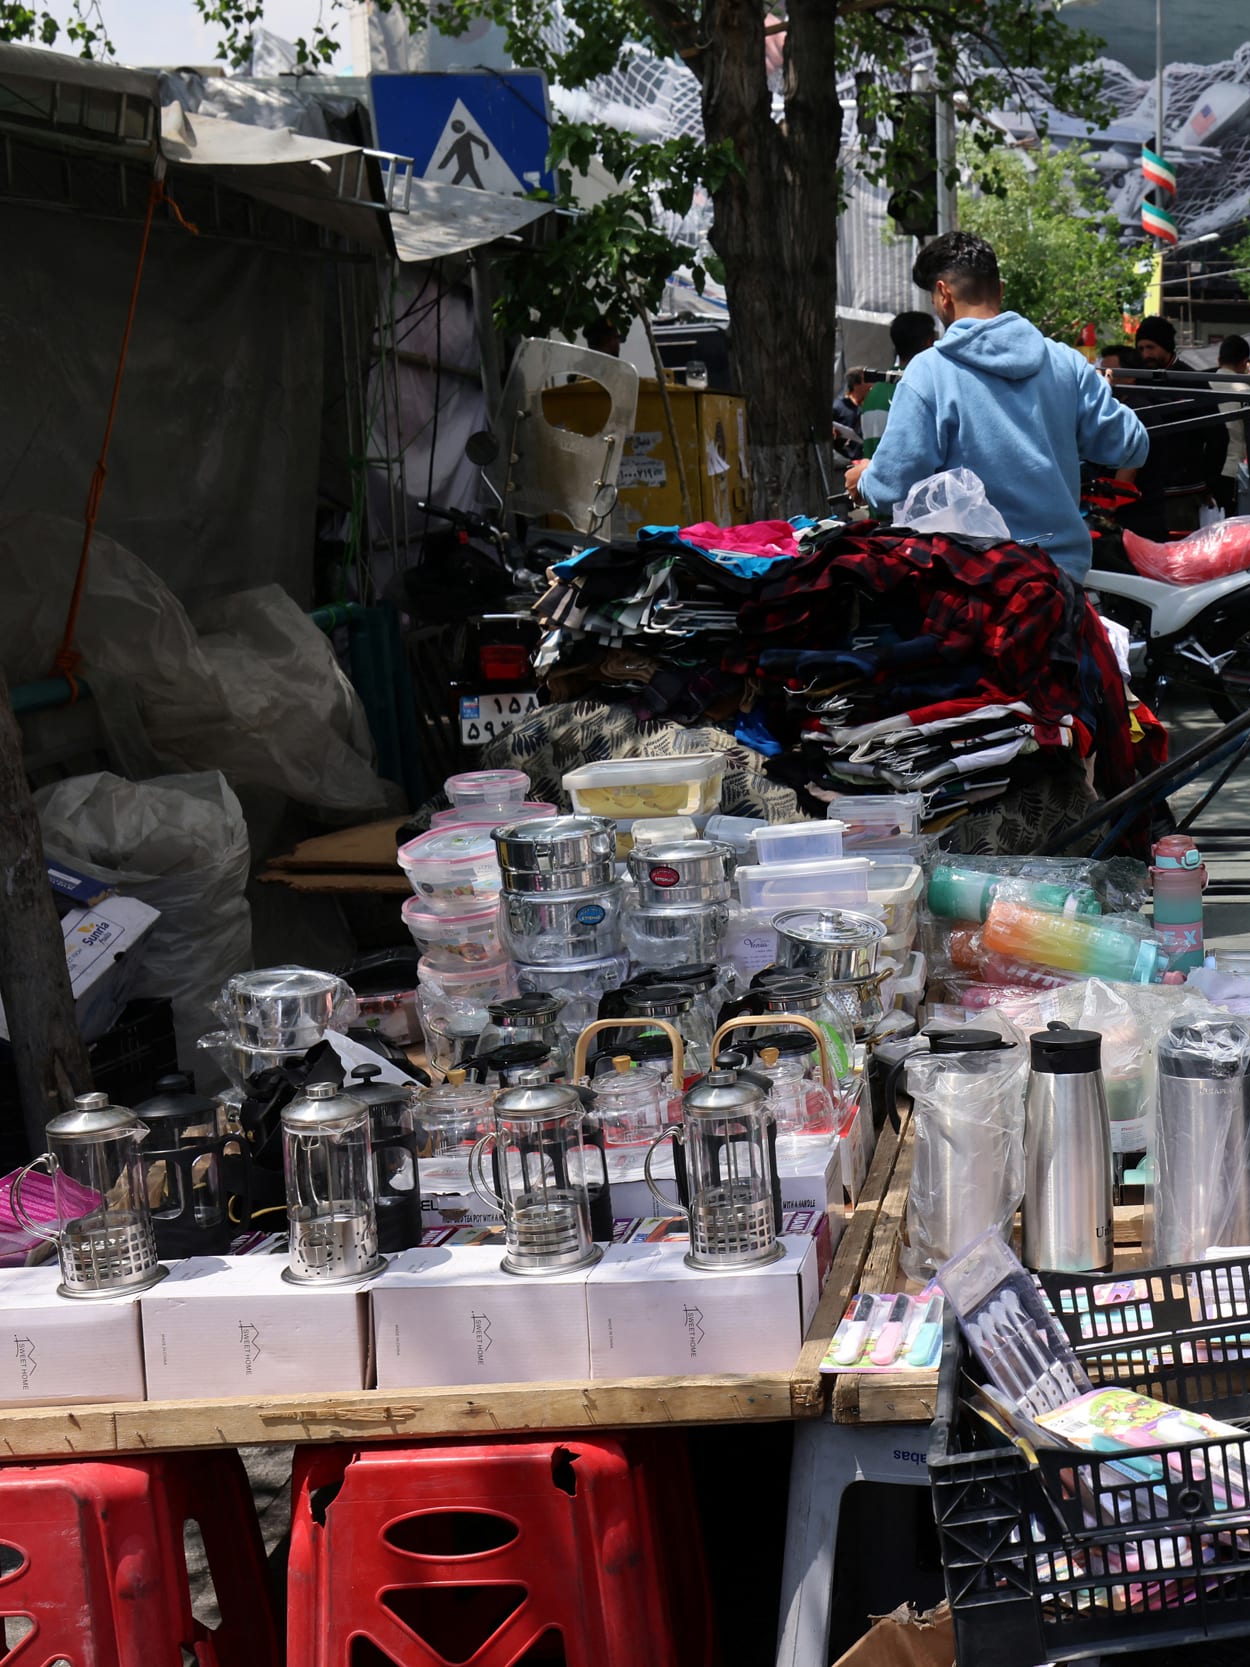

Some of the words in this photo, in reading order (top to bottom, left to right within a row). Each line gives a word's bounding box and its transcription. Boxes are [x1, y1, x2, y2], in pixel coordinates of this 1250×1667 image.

[82, 920, 110, 946] Sunria
[687, 1312, 695, 1336] SWEET
[242, 1329, 251, 1353] SWEET
[19, 1343, 27, 1367] SWEET
[21, 1368, 29, 1390] HOME
